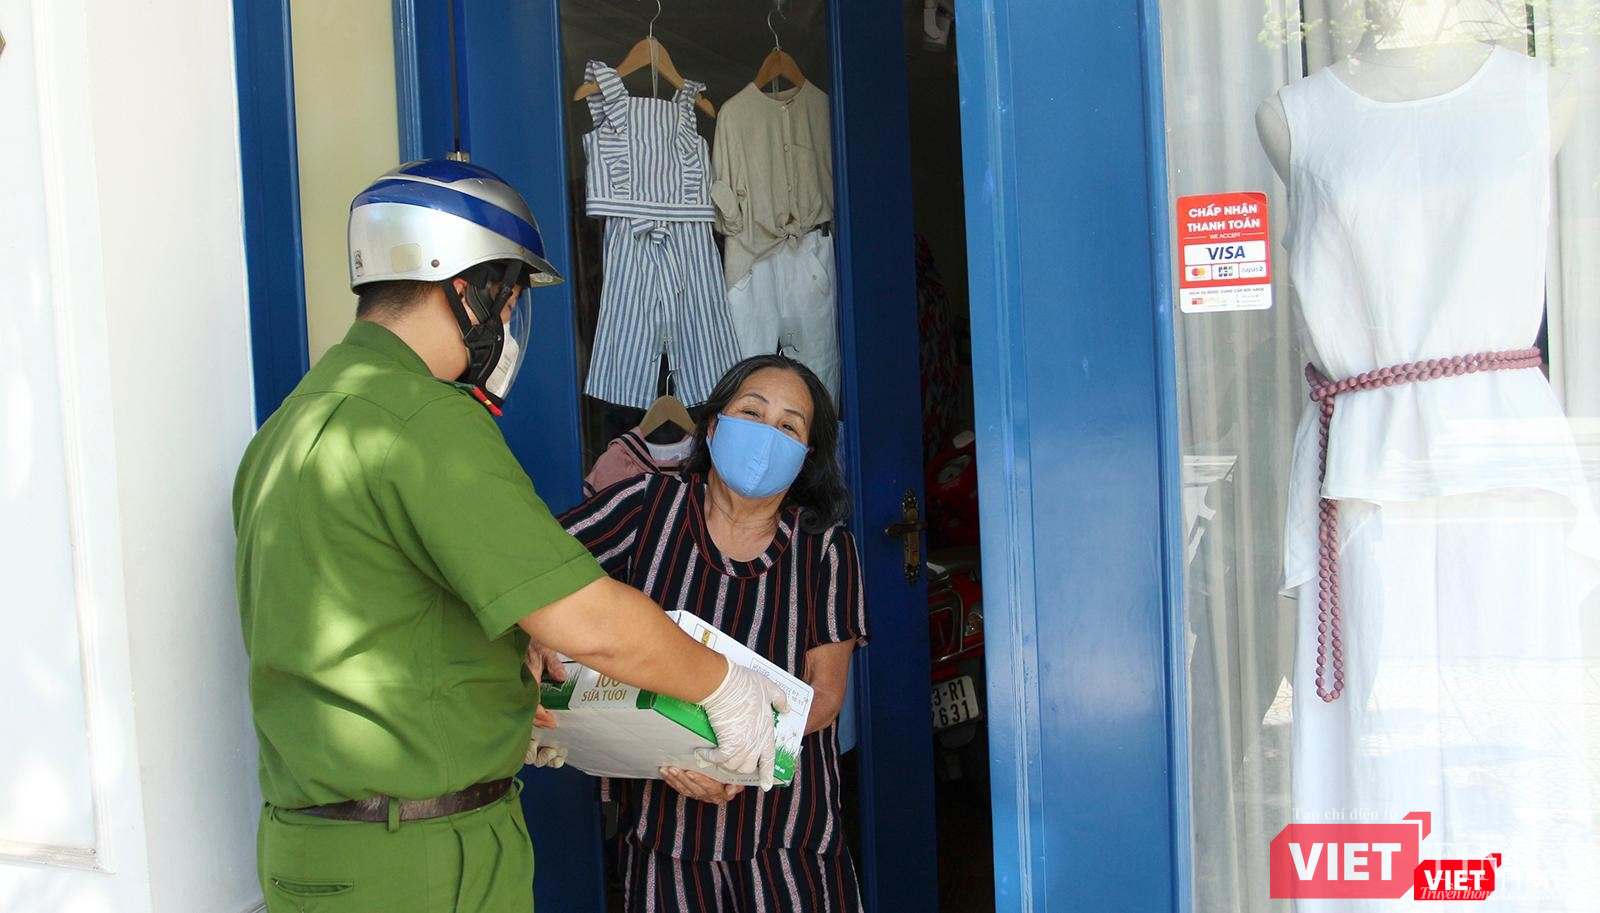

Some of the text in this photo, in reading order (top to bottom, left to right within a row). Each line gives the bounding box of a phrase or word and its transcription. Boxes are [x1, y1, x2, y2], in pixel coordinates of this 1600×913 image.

[1188, 202, 1258, 218] CHẤP NHẬN
[1187, 217, 1260, 232] THANH TOÁN
[1205, 245, 1246, 261] VISA
